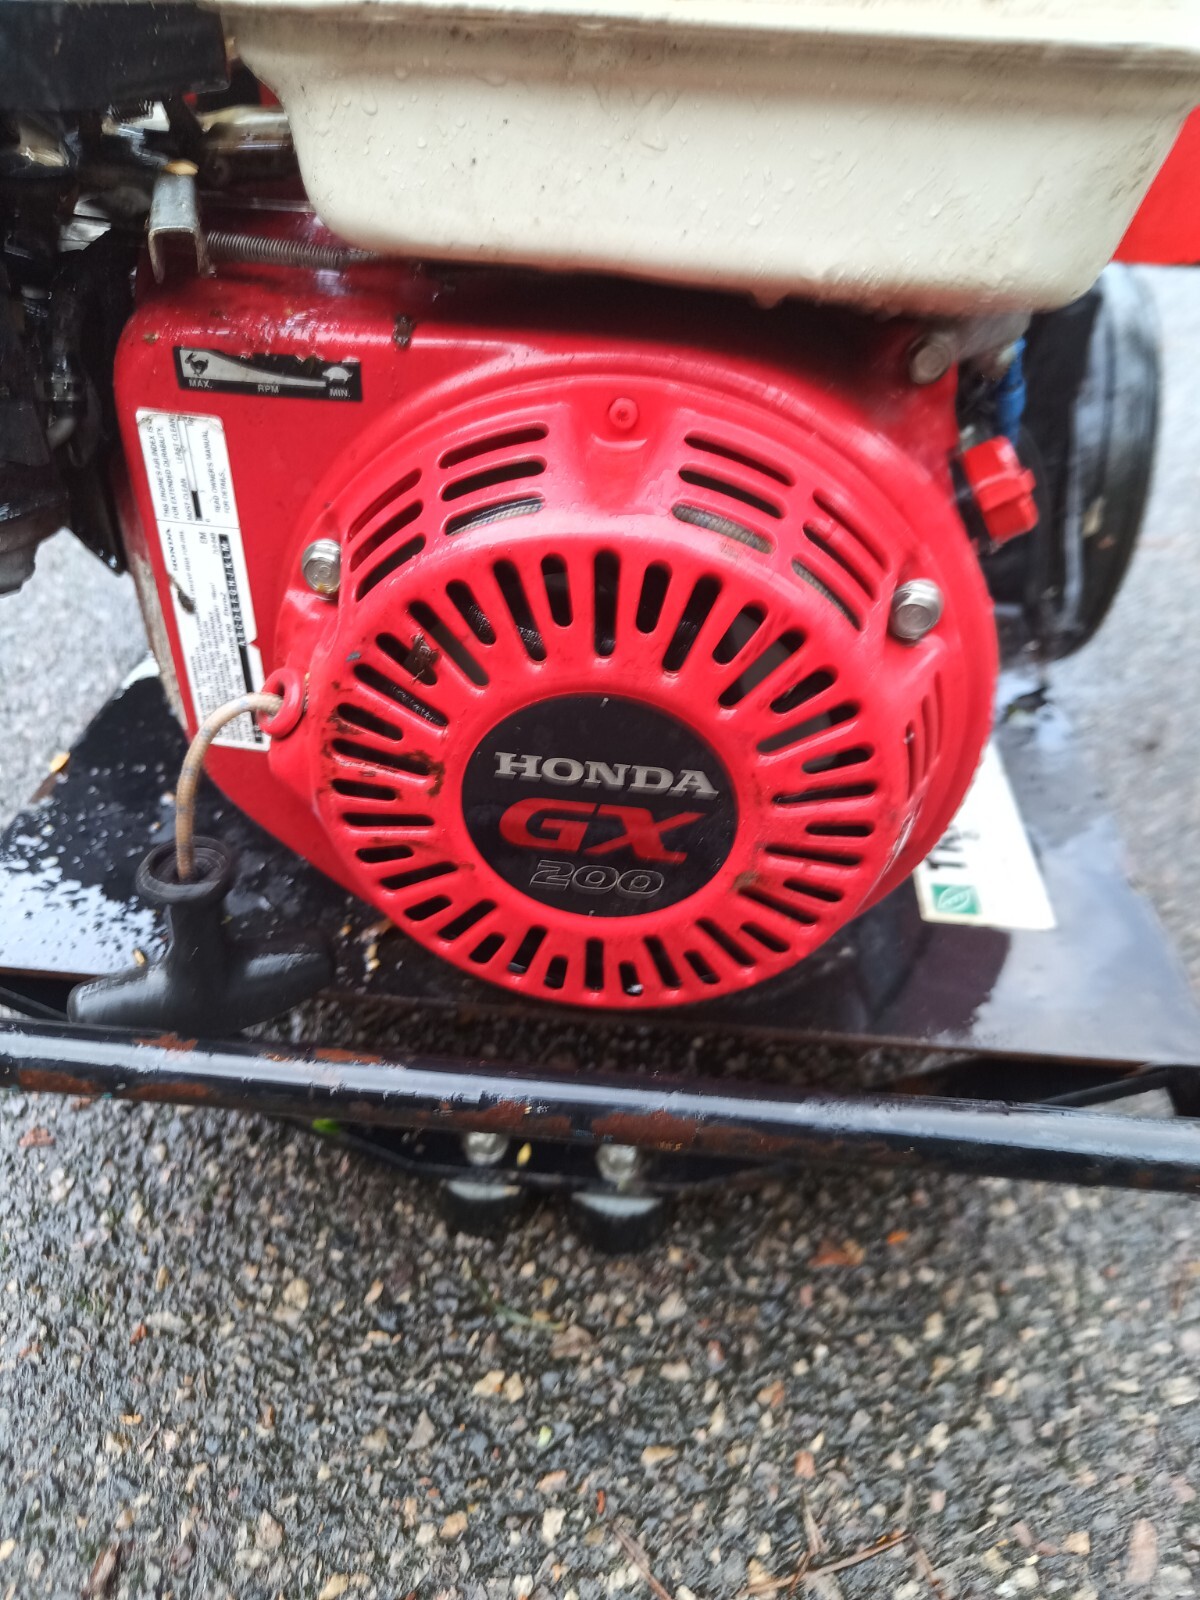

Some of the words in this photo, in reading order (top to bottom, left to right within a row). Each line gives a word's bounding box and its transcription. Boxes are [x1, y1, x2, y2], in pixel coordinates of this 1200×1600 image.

[188, 379, 212, 388] MAX.
[258, 384, 280, 394] RPM
[330, 388, 351, 398] MIN.
[203, 431, 211, 460] MANUAL
[166, 470, 176, 504] EXTENDED
[166, 529, 177, 570] HONDA
[494, 751, 720, 801] HONDA
[500, 797, 707, 864] GX
[529, 859, 665, 900] 200
